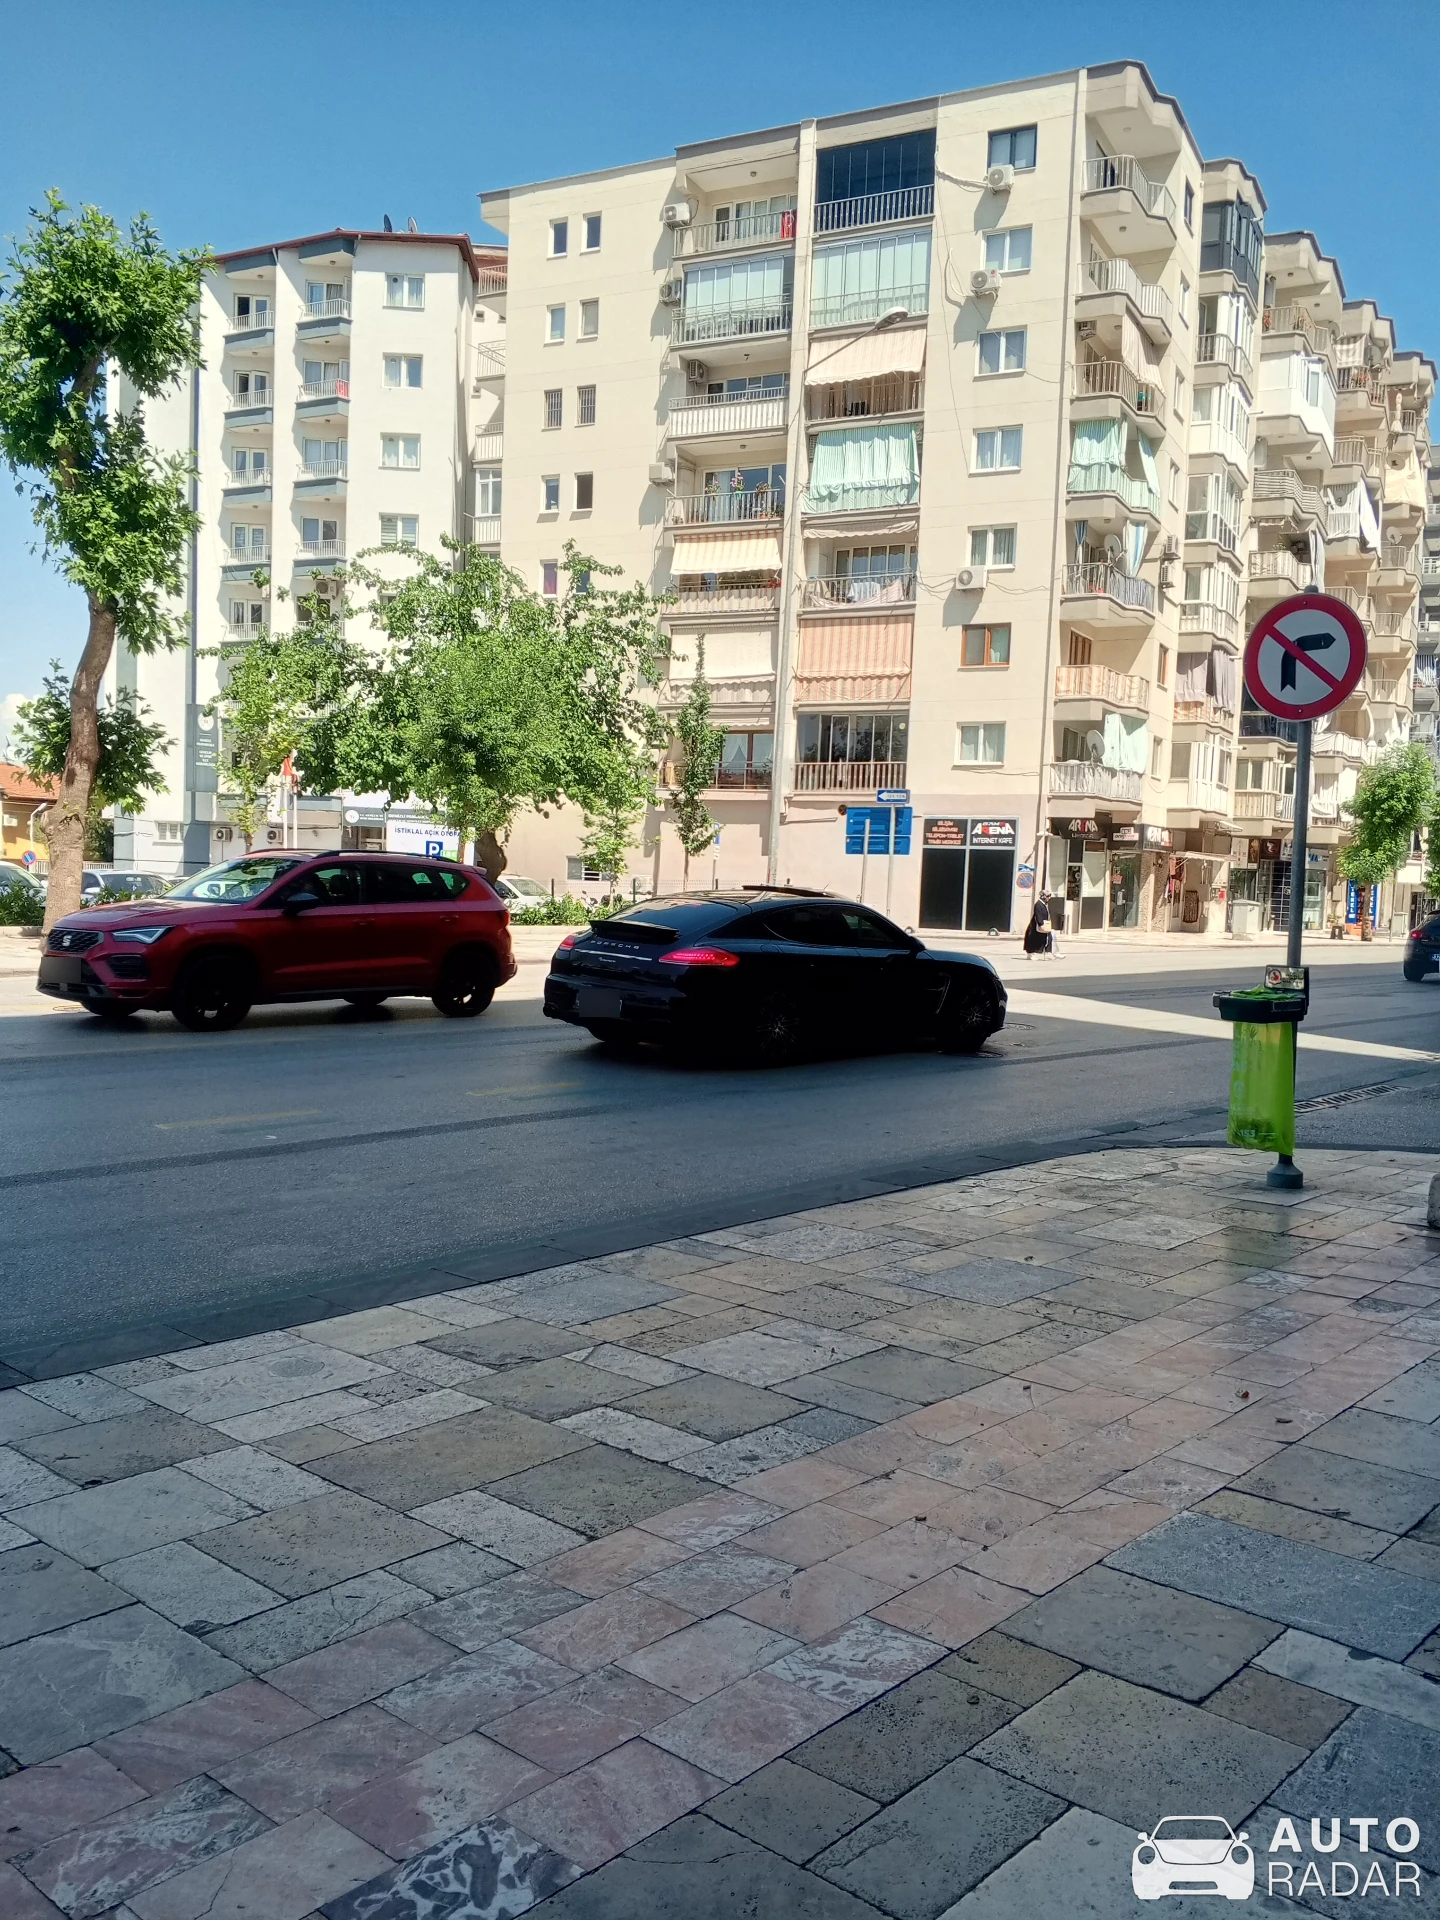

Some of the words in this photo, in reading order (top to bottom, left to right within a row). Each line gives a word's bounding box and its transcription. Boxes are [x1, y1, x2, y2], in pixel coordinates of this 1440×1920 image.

[971, 822, 1015, 835] ARENA
[1068, 819, 1098, 832] ARENA
[394, 827, 423, 835] İSTİKLAL
[424, 829, 440, 838] AÇIK
[590, 940, 640, 950] PORSCHE
